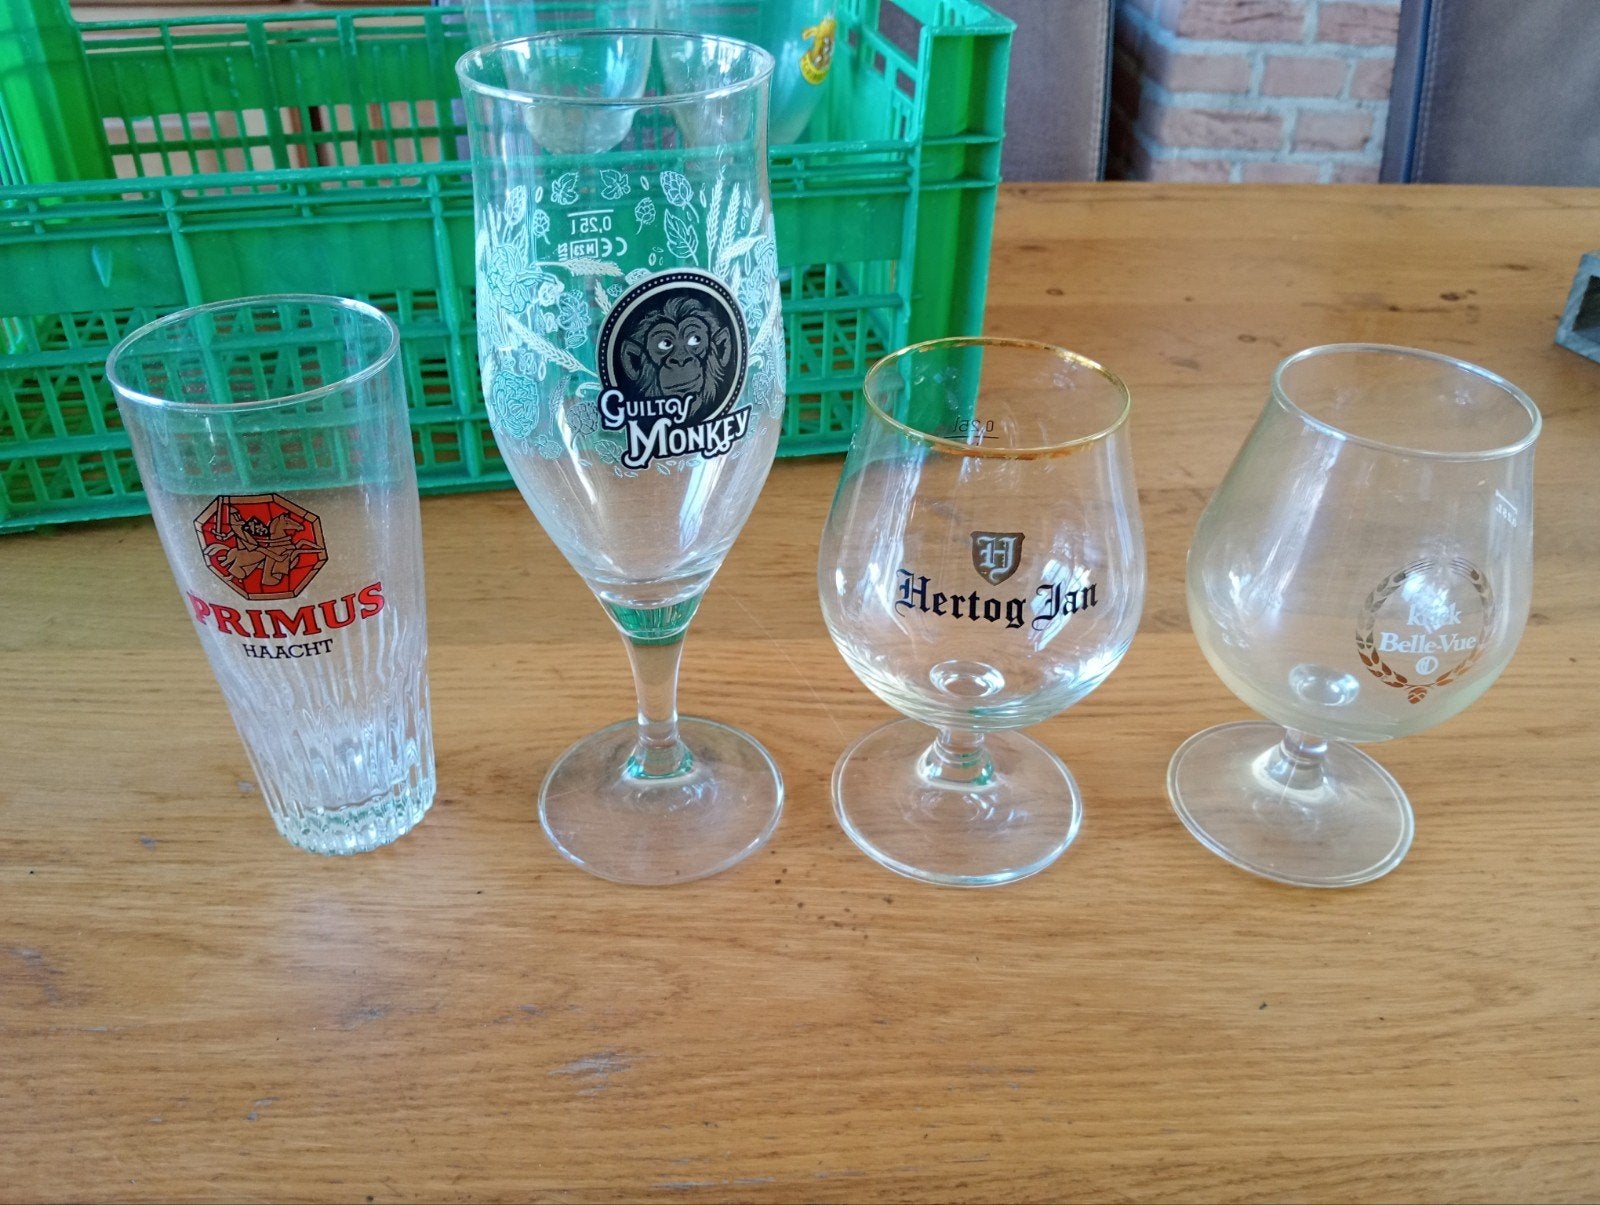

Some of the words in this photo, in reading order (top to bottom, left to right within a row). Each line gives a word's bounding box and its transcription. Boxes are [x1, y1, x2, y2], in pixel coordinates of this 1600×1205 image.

[624, 409, 750, 467] MONKEY
[187, 581, 385, 639] PRIMUS
[894, 568, 1026, 629] Hertog
[1031, 582, 1098, 632] Jan
[243, 639, 334, 660] HAACHT
[1378, 631, 1478, 654] Belle-Vue
